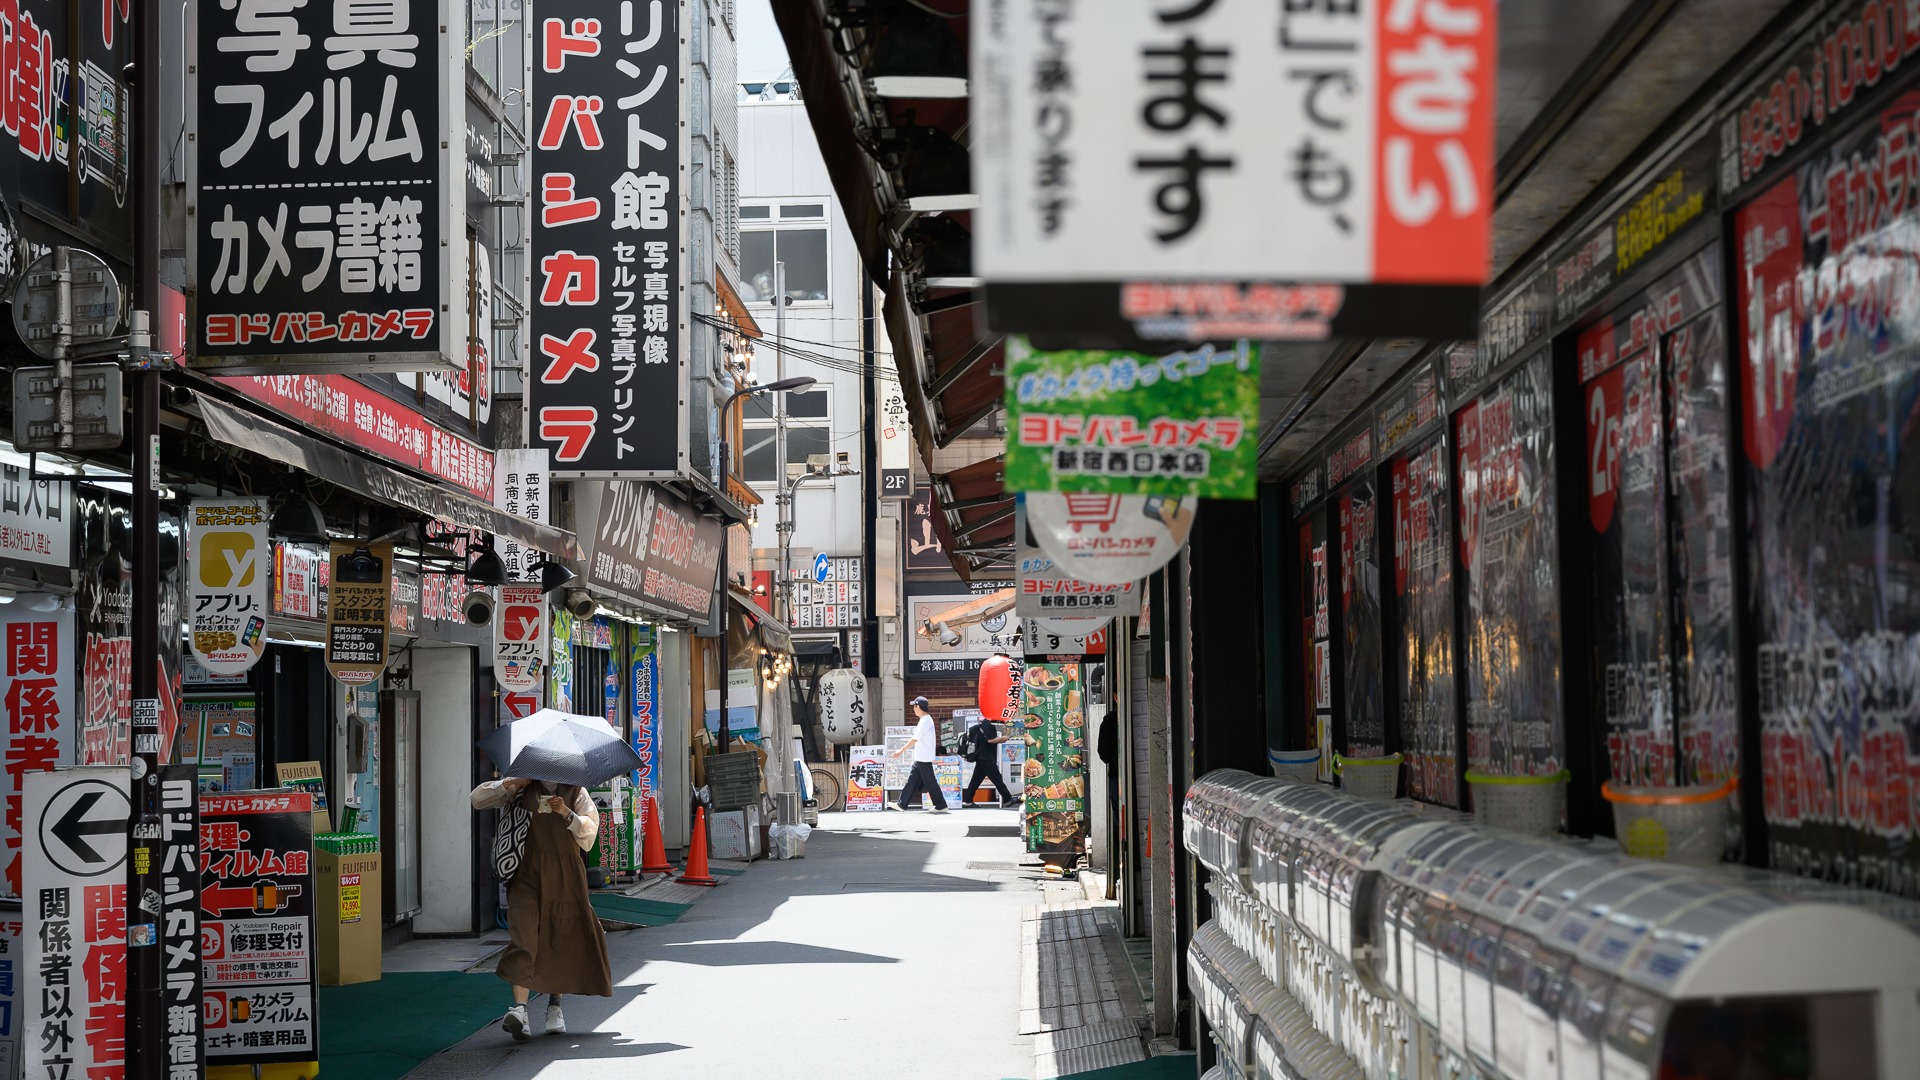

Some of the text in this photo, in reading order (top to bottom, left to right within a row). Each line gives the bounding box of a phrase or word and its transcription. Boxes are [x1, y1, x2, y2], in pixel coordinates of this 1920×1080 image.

[217, 0, 419, 72] 写真
[214, 74, 424, 168] フィルム
[611, 1, 669, 230] リント館
[210, 195, 424, 294] カメラ書籍
[537, 18, 604, 462] ドバシカメラ
[643, 241, 669, 364] 写真現像
[206, 307, 435, 345] ヨドバシカメラ
[611, 241, 637, 460] セルフ写真プリント
[1020, 414, 1244, 448] ヨドバシカメラ
[431, 428, 492, 495] 新規会員募集中
[1056, 451, 1206, 474] 新宿西口本店
[885, 475, 906, 489] 2F
[195, 506, 261, 515] ヨドバシゴールド
[195, 516, 262, 526] ポイントカード
[195, 594, 259, 613] アプリで
[335, 595, 385, 608] スタジオ
[503, 594, 542, 604] ヨドバシ
[1040, 595, 1116, 607] 新宿西口本店
[158, 595, 175, 627] air
[334, 608, 385, 622] 証明写真
[333, 641, 375, 650] こだわりの
[920, 660, 965, 671] 営業時間
[969, 660, 980, 671] 16
[182, 702, 234, 711] 類と対応機種
[850, 694, 865, 736] 大黒
[281, 766, 317, 779] FUJIFILM
[849, 764, 883, 789] 半額
[342, 860, 377, 874] FUJIFILM
[271, 922, 302, 932] Repair
[230, 932, 304, 952] 修理受付
[217, 961, 299, 972] 時計の修理・電池交換は
[217, 970, 293, 981] 時計総合館で承ります。
[83, 884, 126, 1080] 関係者
[251, 992, 295, 1008] カメラ
[251, 1007, 309, 1024] フィルム
[205, 1029, 307, 1049] ェキ・暗室用品
